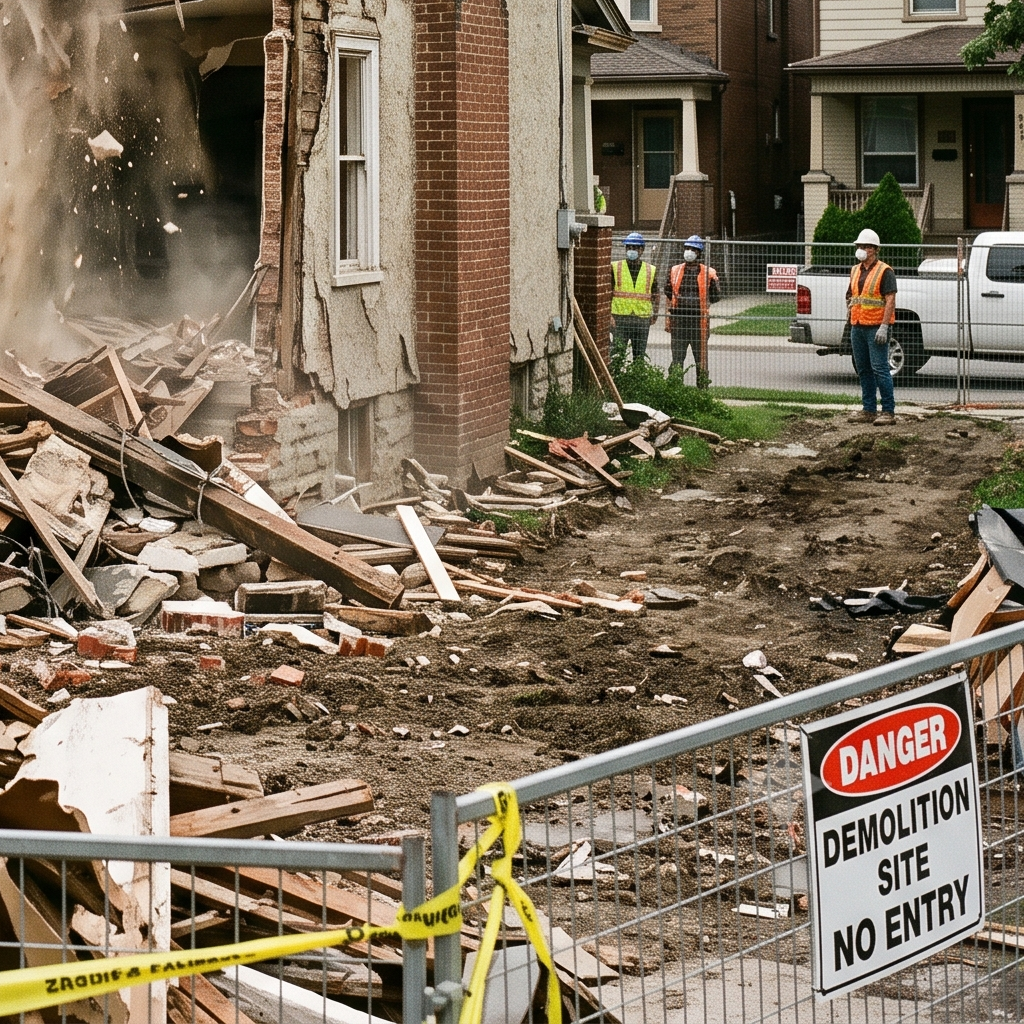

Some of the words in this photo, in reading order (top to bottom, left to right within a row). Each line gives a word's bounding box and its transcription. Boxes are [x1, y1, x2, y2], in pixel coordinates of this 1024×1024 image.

[838, 714, 947, 787] DANGER
[823, 777, 970, 868] DEMOLITION
[878, 842, 931, 897] SITE
[833, 917, 877, 972] NO
[885, 874, 969, 951] ENTRY
